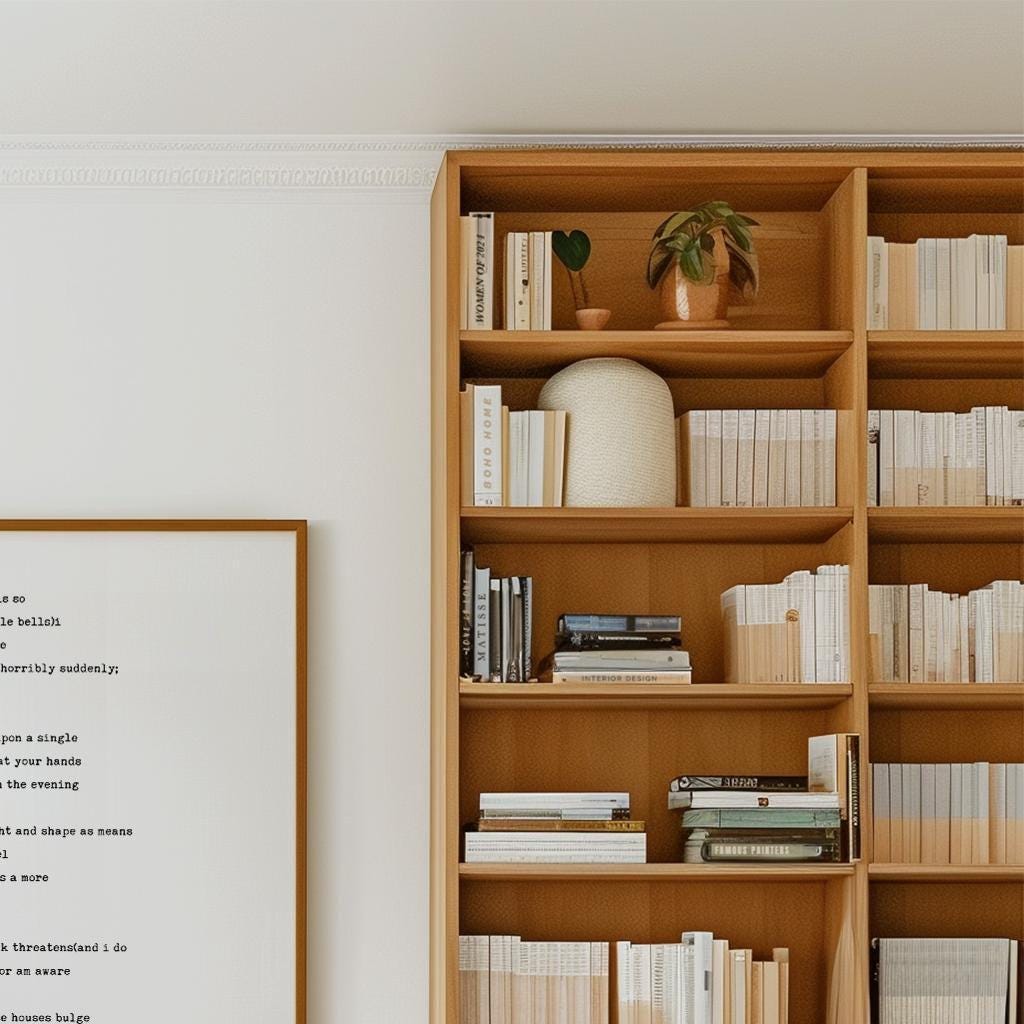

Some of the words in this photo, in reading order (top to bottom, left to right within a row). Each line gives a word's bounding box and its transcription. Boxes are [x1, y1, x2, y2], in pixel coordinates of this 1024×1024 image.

[476, 260, 486, 276] OF
[475, 277, 485, 323] WOMEN
[483, 397, 493, 440] HOME
[483, 447, 493, 489] BOHO
[11, 595, 26, 604] so
[16, 616, 62, 627] bells)i
[477, 593, 487, 662] MATISSE
[0, 662, 56, 676] horribly
[59, 662, 119, 676] suddenly;
[25, 734, 34, 743] a
[36, 732, 79, 745] single
[14, 758, 43, 769] your
[45, 755, 82, 767] hands
[5, 779, 27, 790] the
[30, 779, 80, 792] evening
[14, 825, 38, 836] and
[40, 825, 77, 839] shape
[79, 828, 95, 837] as
[97, 828, 133, 837] means
[713, 845, 748, 856] FAMOUS
[750, 845, 790, 856] PAINTERS
[9, 874, 18, 883] a
[20, 874, 49, 883] more
[12, 942, 99, 953] threatens(and
[102, 943, 110, 953] i
[112, 942, 128, 953] do
[15, 968, 32, 976] am
[34, 968, 71, 977] aware
[10, 1012, 53, 1023] houses
[55, 1012, 91, 1024] bulge
